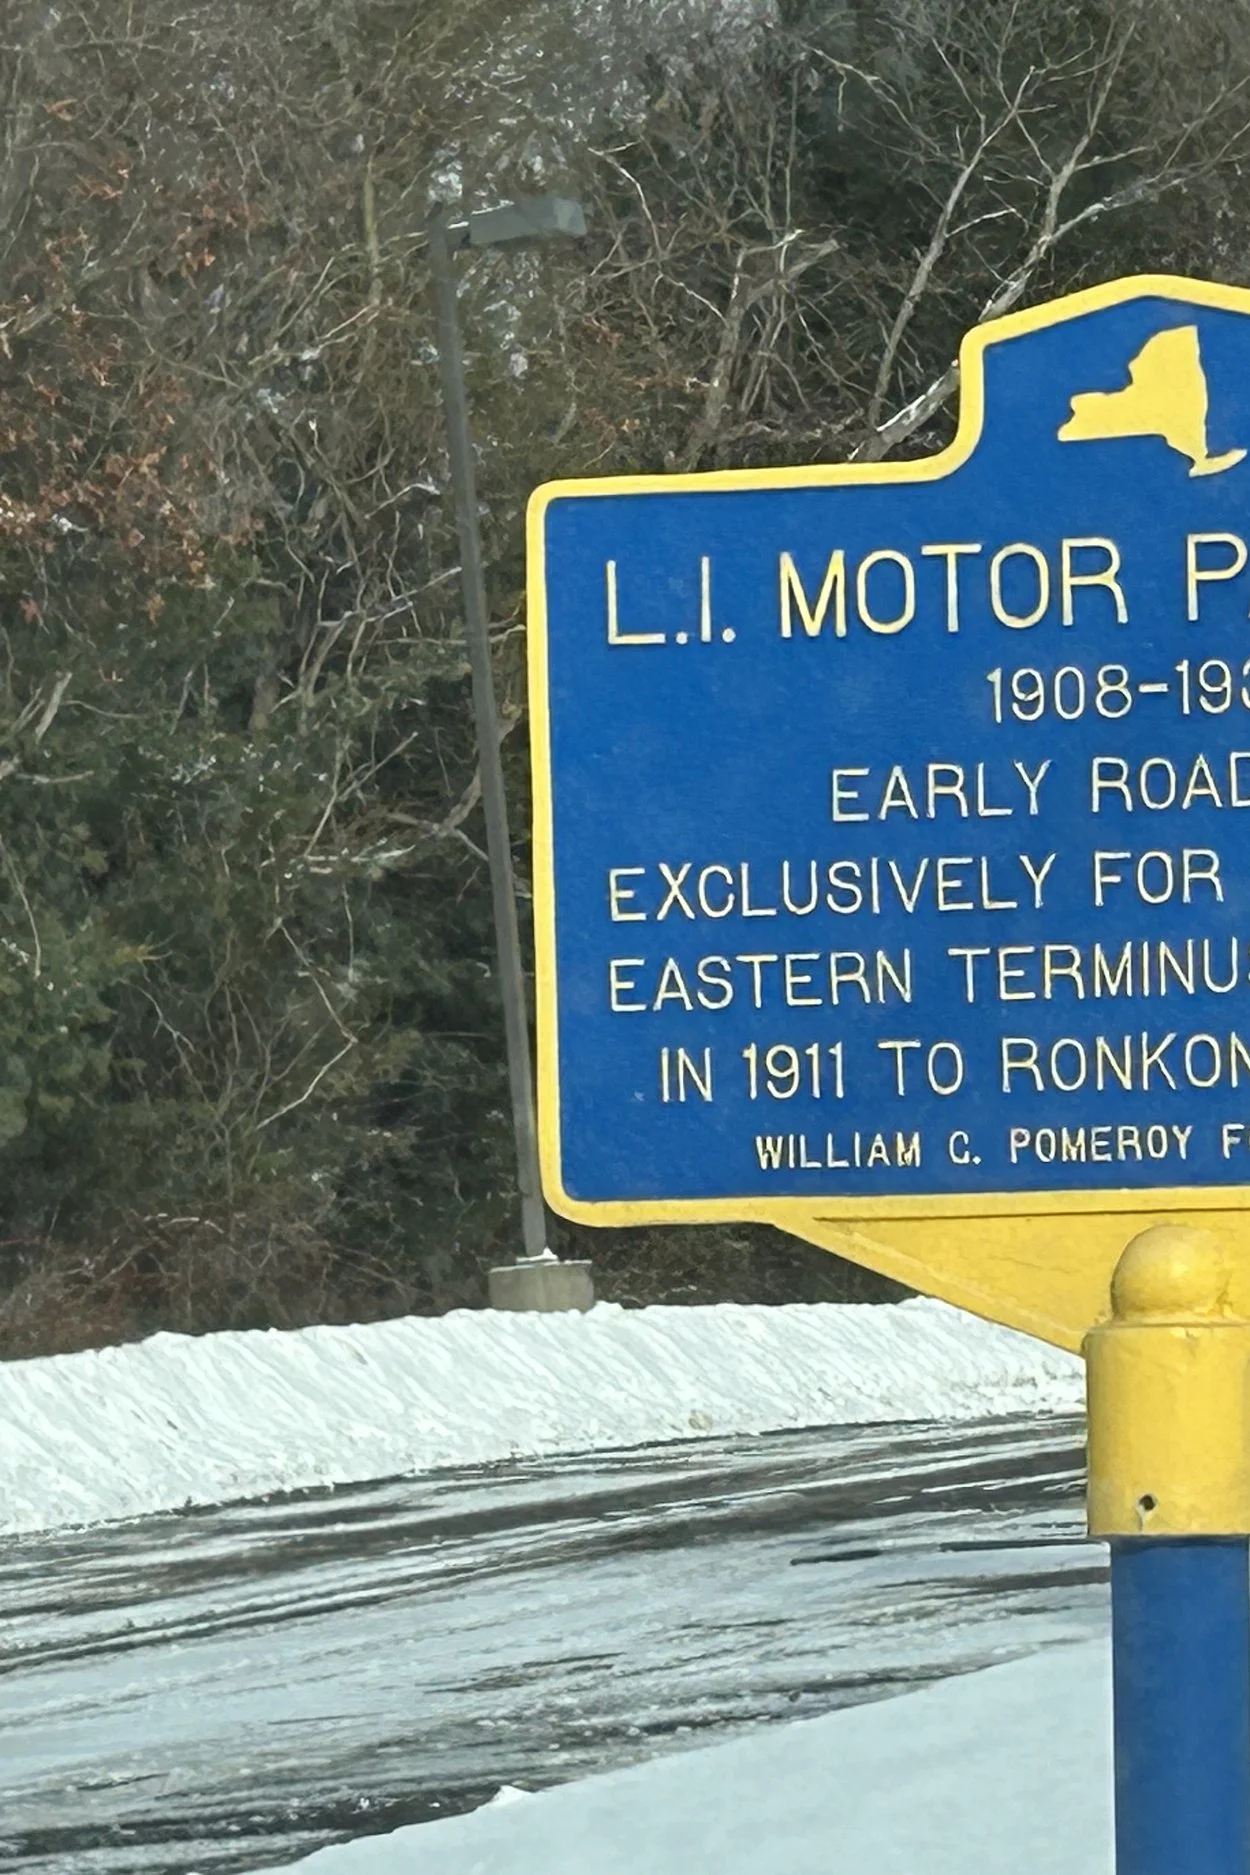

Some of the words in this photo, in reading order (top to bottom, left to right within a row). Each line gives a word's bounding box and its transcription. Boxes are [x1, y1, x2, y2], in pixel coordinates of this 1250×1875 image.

[605, 555, 738, 646] L.I.
[778, 535, 1130, 639] MOTOR
[831, 758, 1052, 823] EARLY
[608, 852, 1057, 923] EXCLUSIVELY
[1093, 847, 1226, 908] FOR
[608, 946, 913, 1013] EASTERN
[660, 1045, 714, 1104] IN
[741, 1040, 845, 1101] 1911
[876, 1038, 965, 1097] TO
[754, 1130, 922, 1171] WILLIAM
[947, 1129, 983, 1166] C.
[1009, 1123, 1194, 1165] POMEROY
